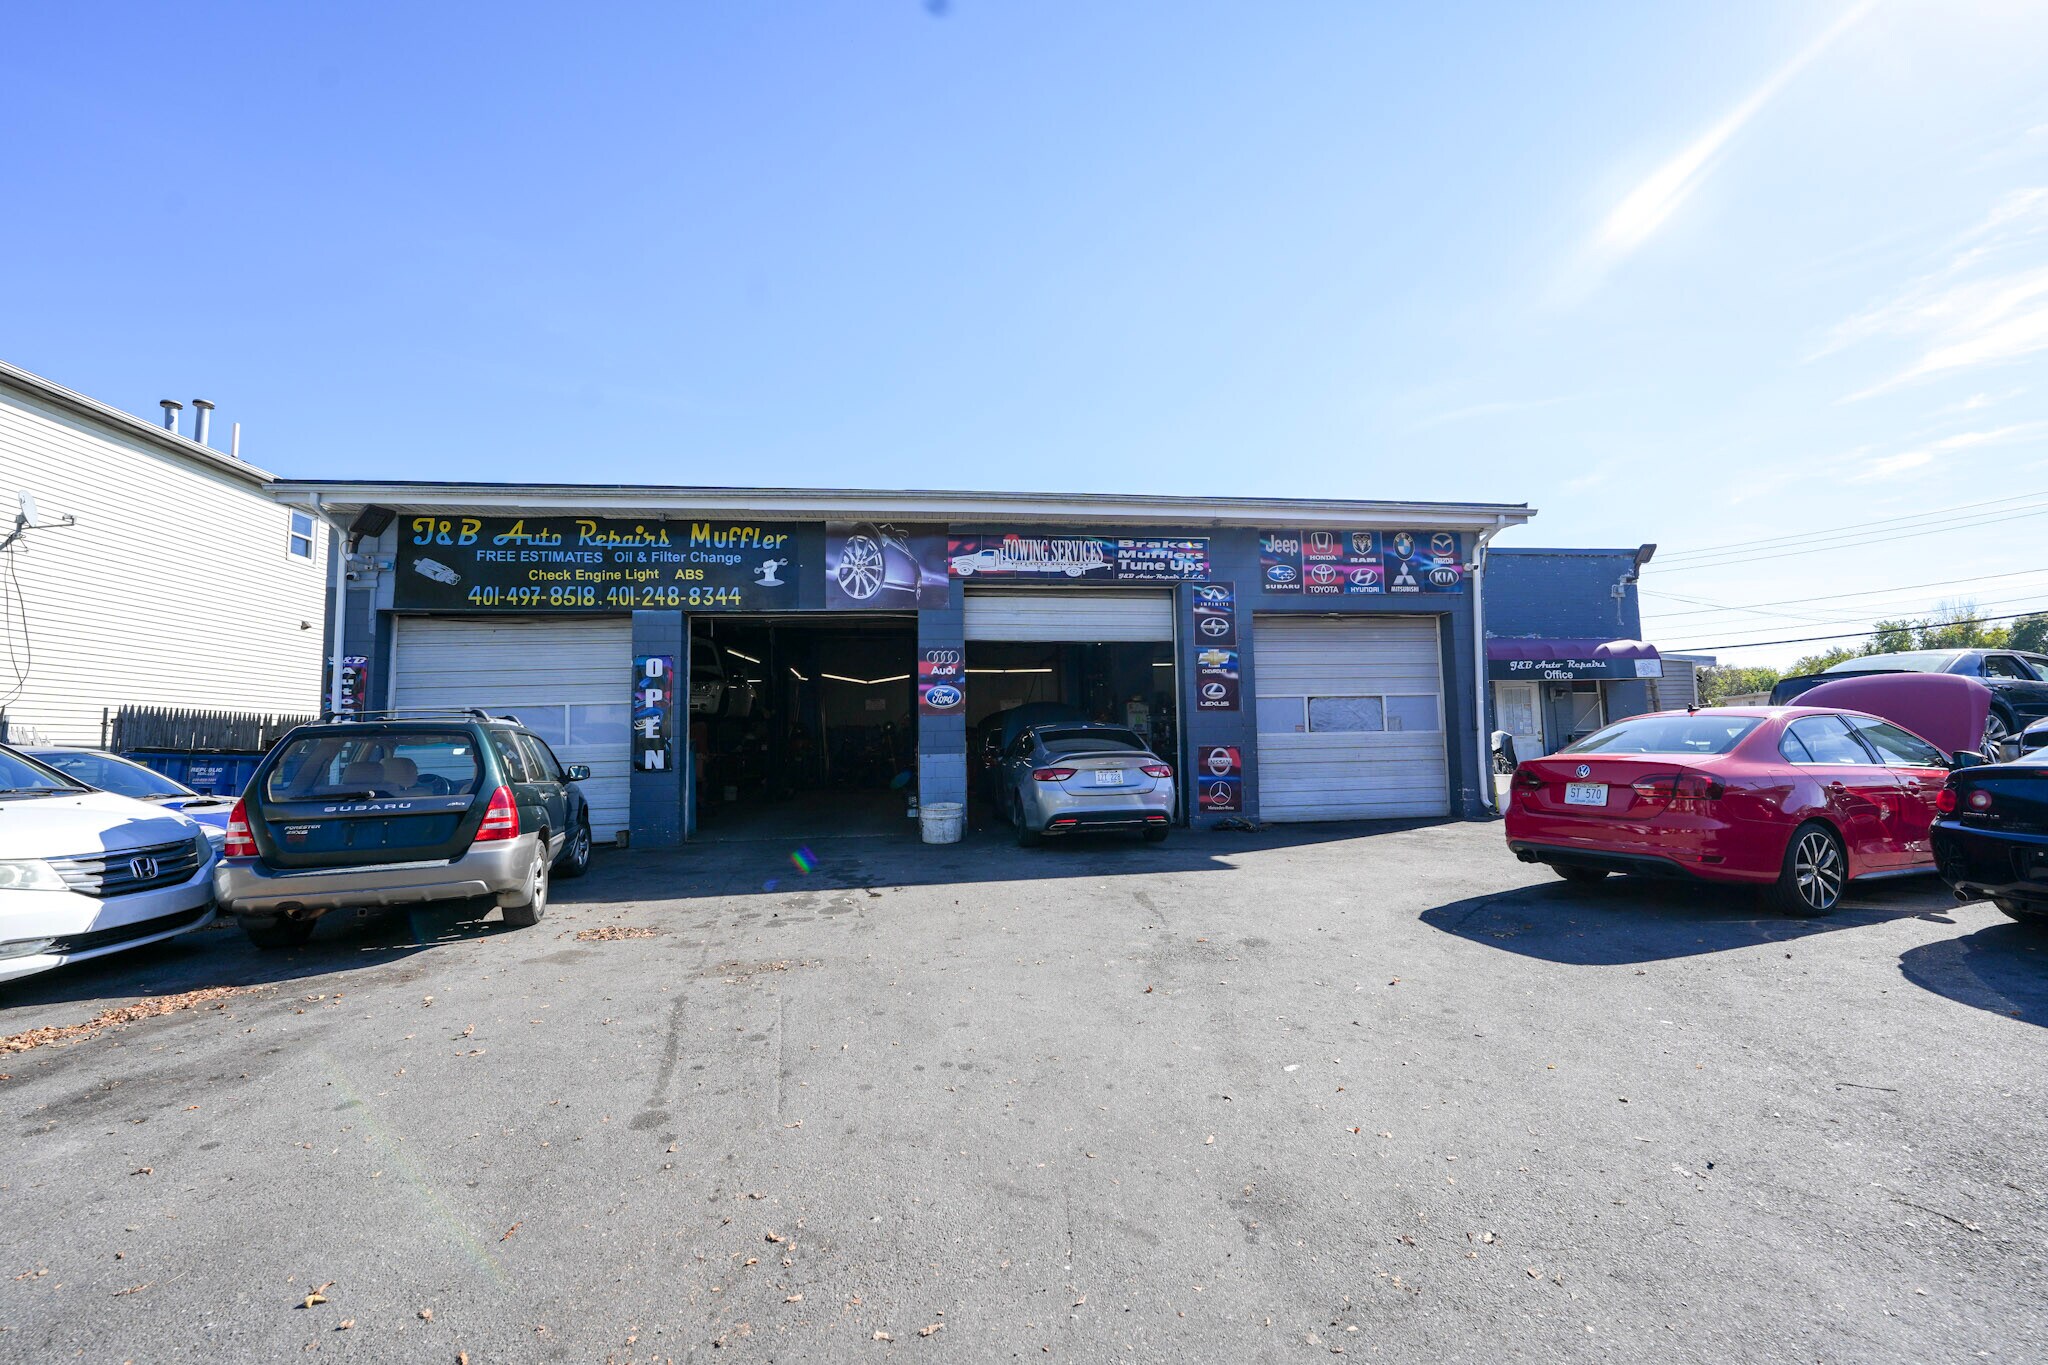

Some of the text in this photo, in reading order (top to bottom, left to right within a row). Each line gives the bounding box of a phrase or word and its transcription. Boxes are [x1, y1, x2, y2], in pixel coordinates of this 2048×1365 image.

[412, 517, 789, 550] J&B Auto Repairs Muffler
[1117, 540, 1204, 549] Brakes
[1265, 534, 1299, 557] Jeep
[1003, 539, 1104, 563] TOWING SERVICES
[1117, 550, 1204, 559] Mufflers
[476, 550, 742, 566] FREE ESTIMATES Oil & Filter Change
[1117, 559, 1204, 574] Tune Ups
[528, 569, 704, 583] Check Engine Light ABS
[1434, 571, 1454, 583] KIA
[1309, 586, 1339, 594] TOYOTA
[1390, 585, 1420, 593] MITSUBISHI
[606, 586, 742, 607] 401-248-8344
[930, 665, 956, 675] Audi
[1509, 659, 1606, 671] J&B Auto Repairs
[1544, 670, 1573, 680] Office
[931, 688, 955, 704] Ford
[644, 658, 665, 770] OPEN
[1570, 787, 1602, 799] ST 570
[323, 802, 412, 813] SUBARU
